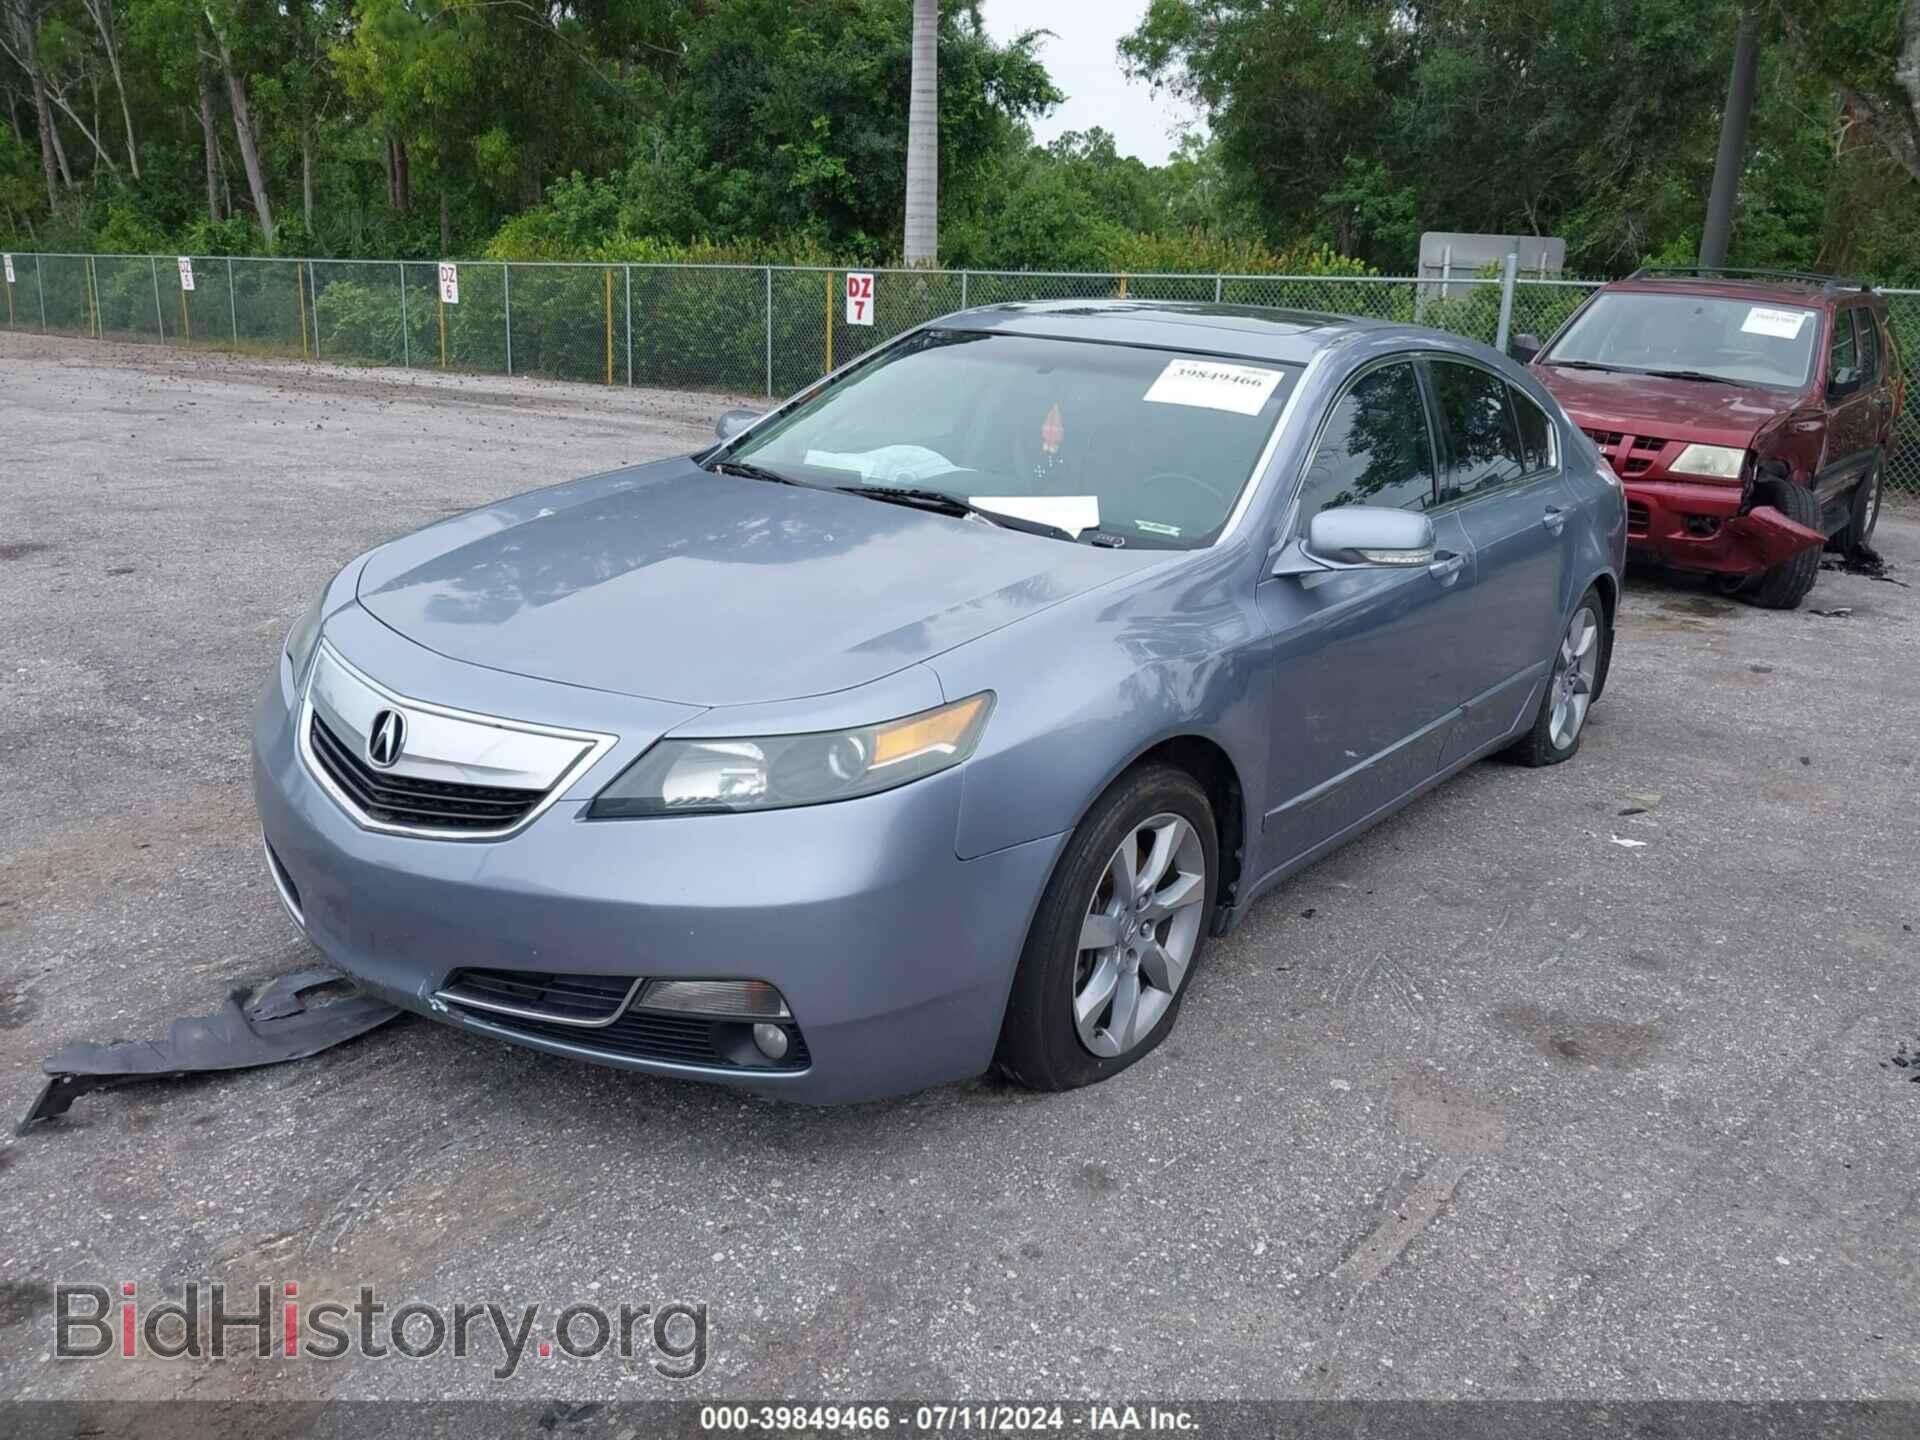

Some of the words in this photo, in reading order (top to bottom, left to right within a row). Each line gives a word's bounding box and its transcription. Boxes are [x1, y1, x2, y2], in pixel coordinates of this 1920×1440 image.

[441, 266, 456, 283] DZ
[446, 284, 453, 299] 6
[848, 277, 871, 298] DZ
[854, 300, 865, 321] 7
[1173, 367, 1263, 387] 39849466
